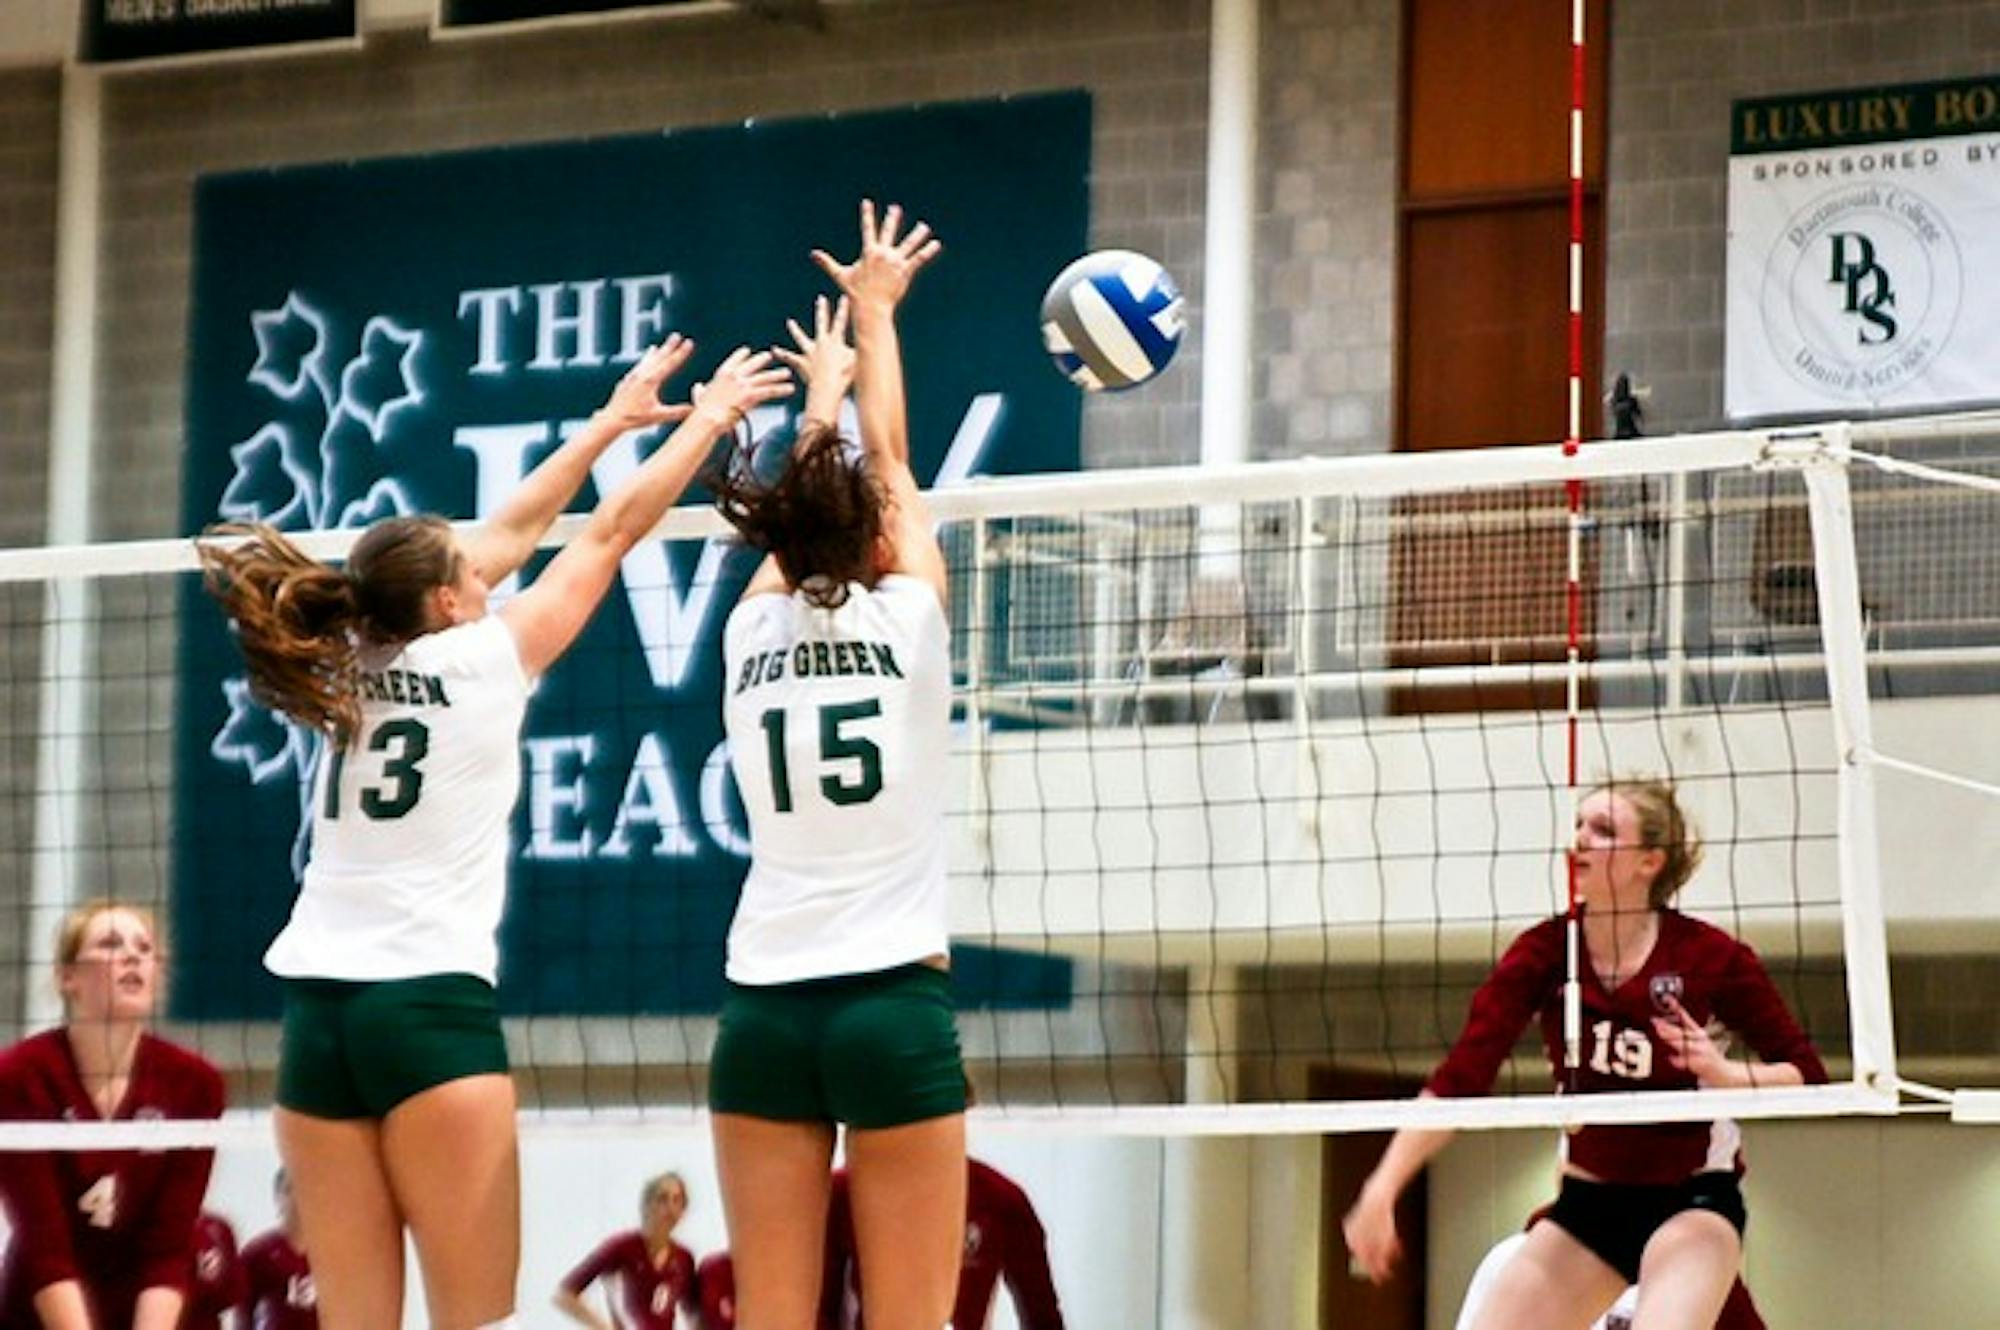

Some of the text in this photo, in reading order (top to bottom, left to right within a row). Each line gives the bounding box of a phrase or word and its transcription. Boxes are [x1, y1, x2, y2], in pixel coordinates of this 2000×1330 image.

[1743, 86, 2000, 144] LUXURY BO
[1753, 143, 2000, 181] SPONSORED BY
[456, 272, 675, 376] THE
[735, 640, 905, 695] BIG GREEN
[323, 717, 430, 821] 13
[760, 696, 884, 813] 15
[1589, 1020, 1653, 1080] 19
[77, 1172, 119, 1229] 4
